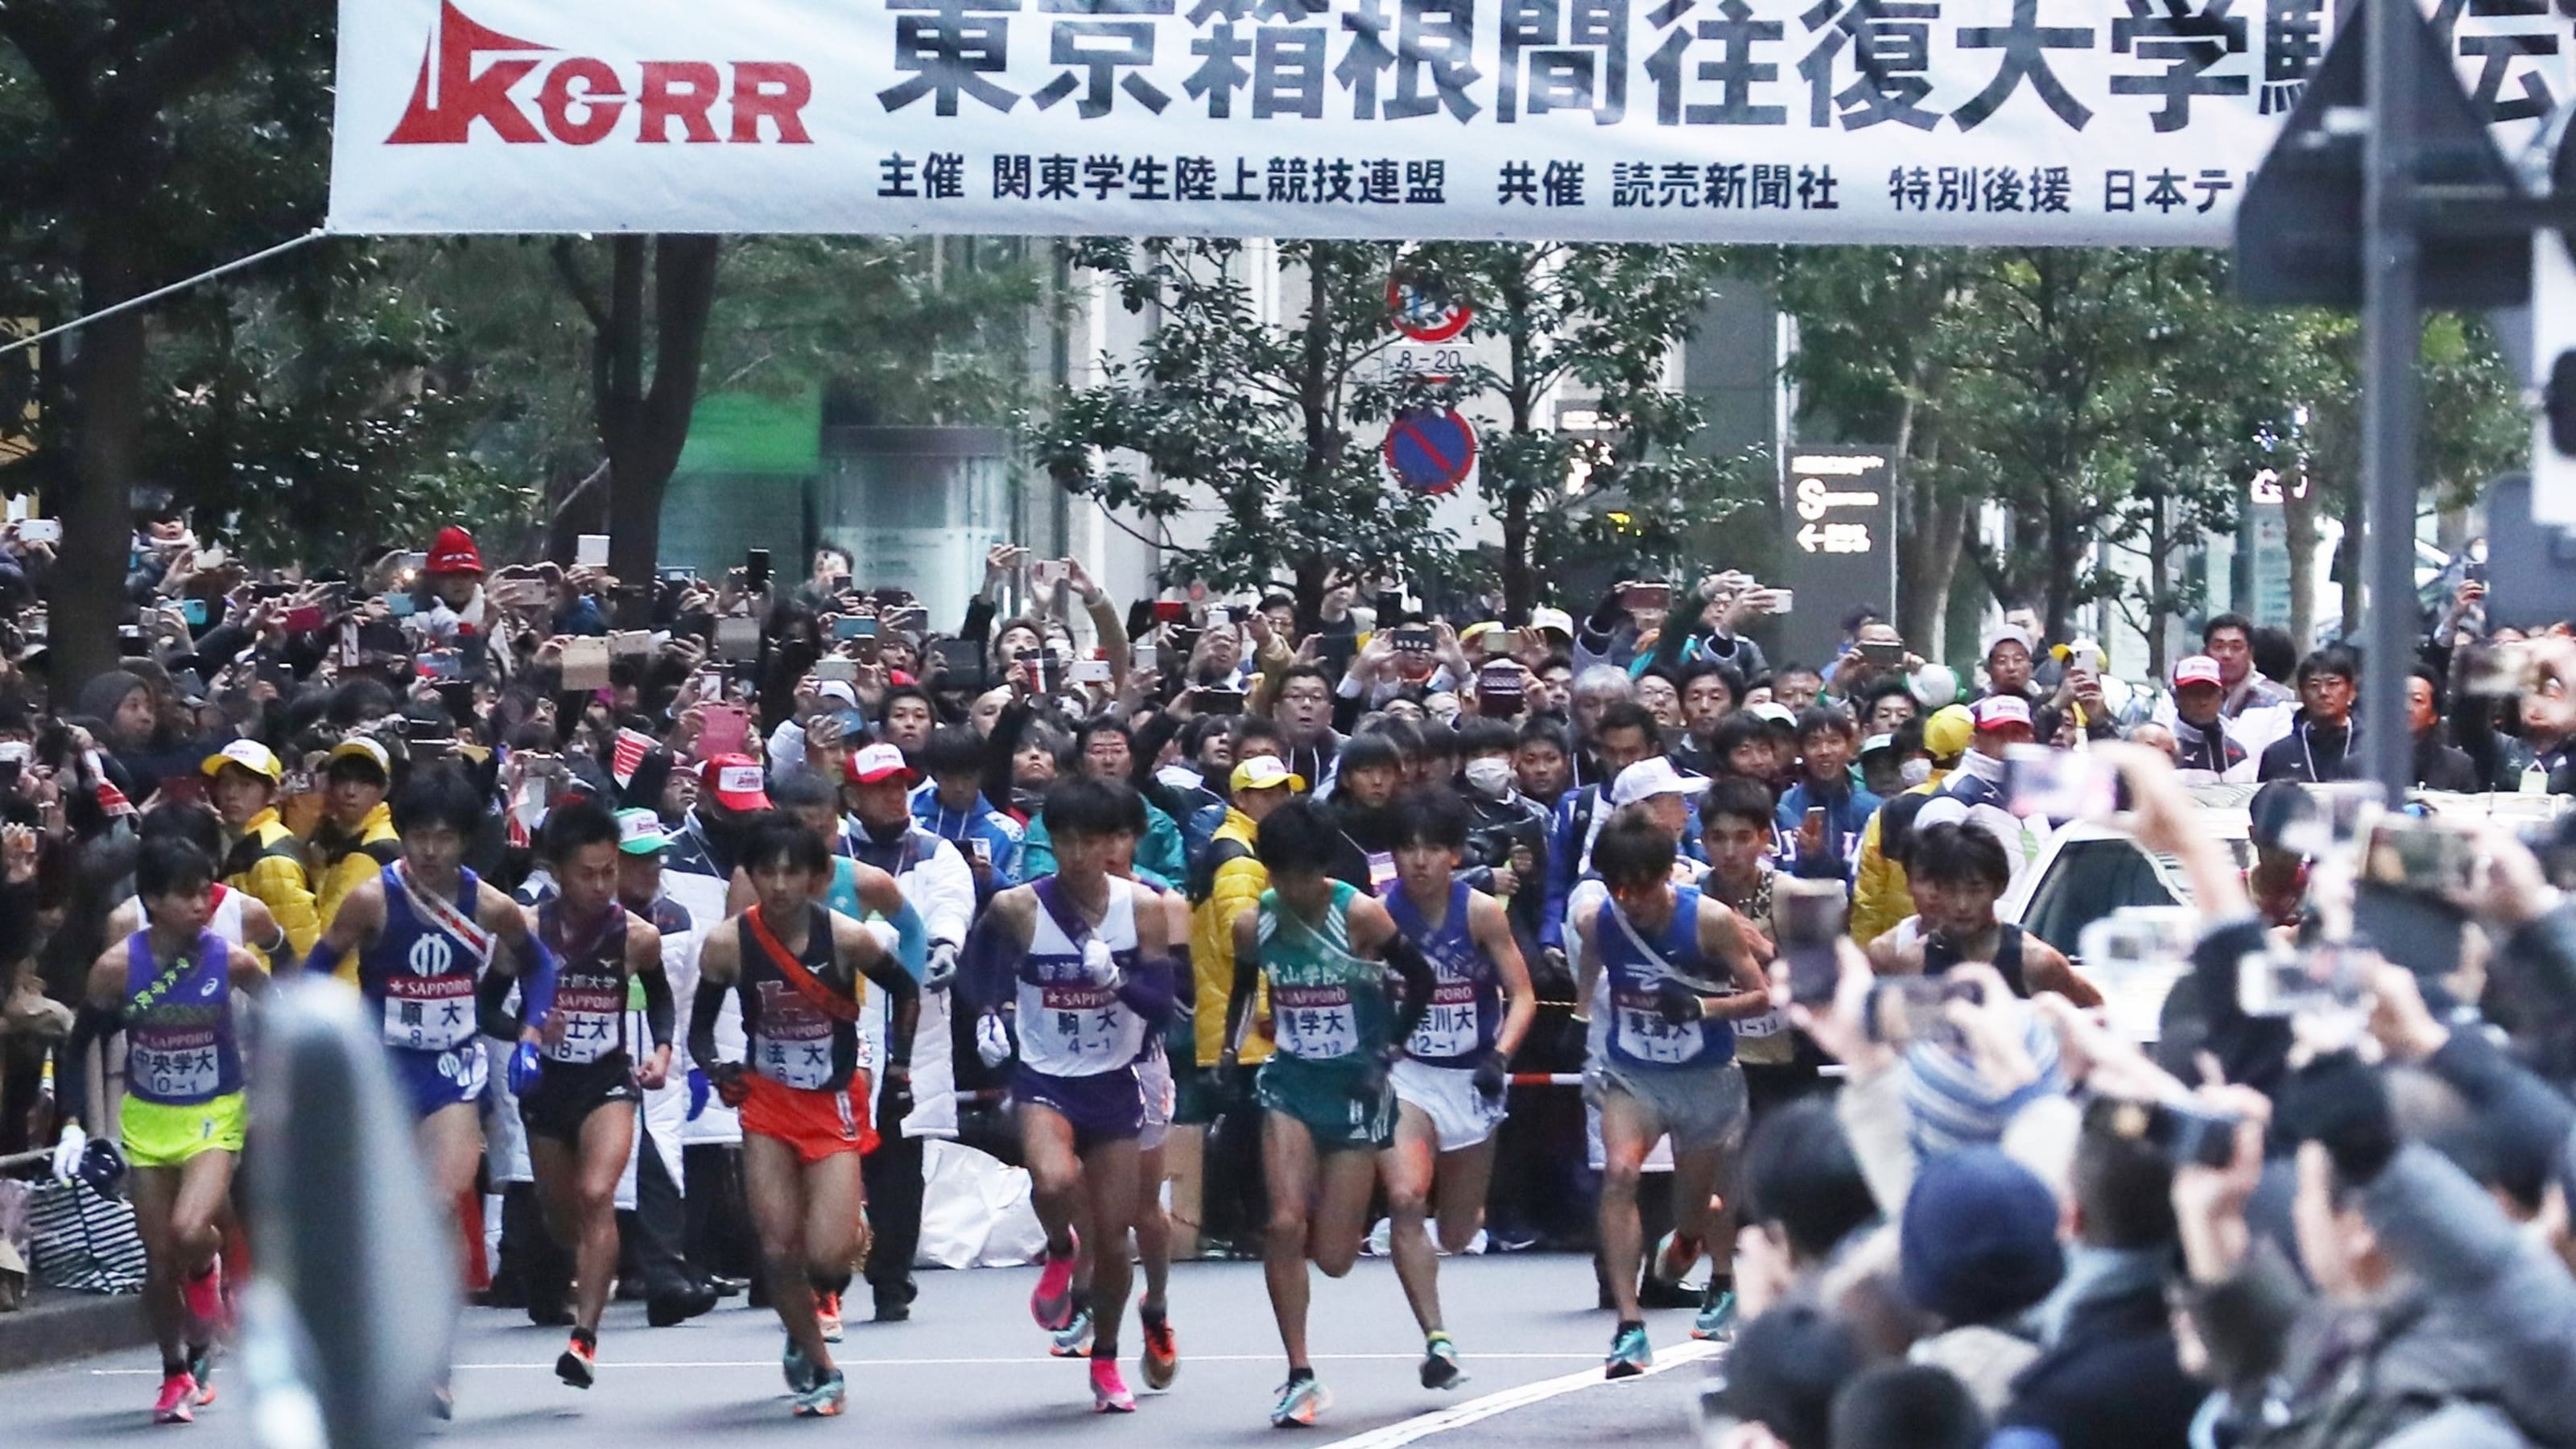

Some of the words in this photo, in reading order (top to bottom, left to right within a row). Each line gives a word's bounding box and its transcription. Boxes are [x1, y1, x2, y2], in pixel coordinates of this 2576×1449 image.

[877, 151, 964, 199] 主催
[993, 153, 1446, 204] 関東学生陸上競技連盟
[1498, 161, 1585, 207] 共催
[1612, 163, 1839, 210] 読売新聞社
[1889, 166, 2071, 213] 特別後援
[2104, 168, 2254, 213] 日本テ
[408, 979, 472, 996] SAPPORO
[150, 1031, 214, 1046] SAPPORO
